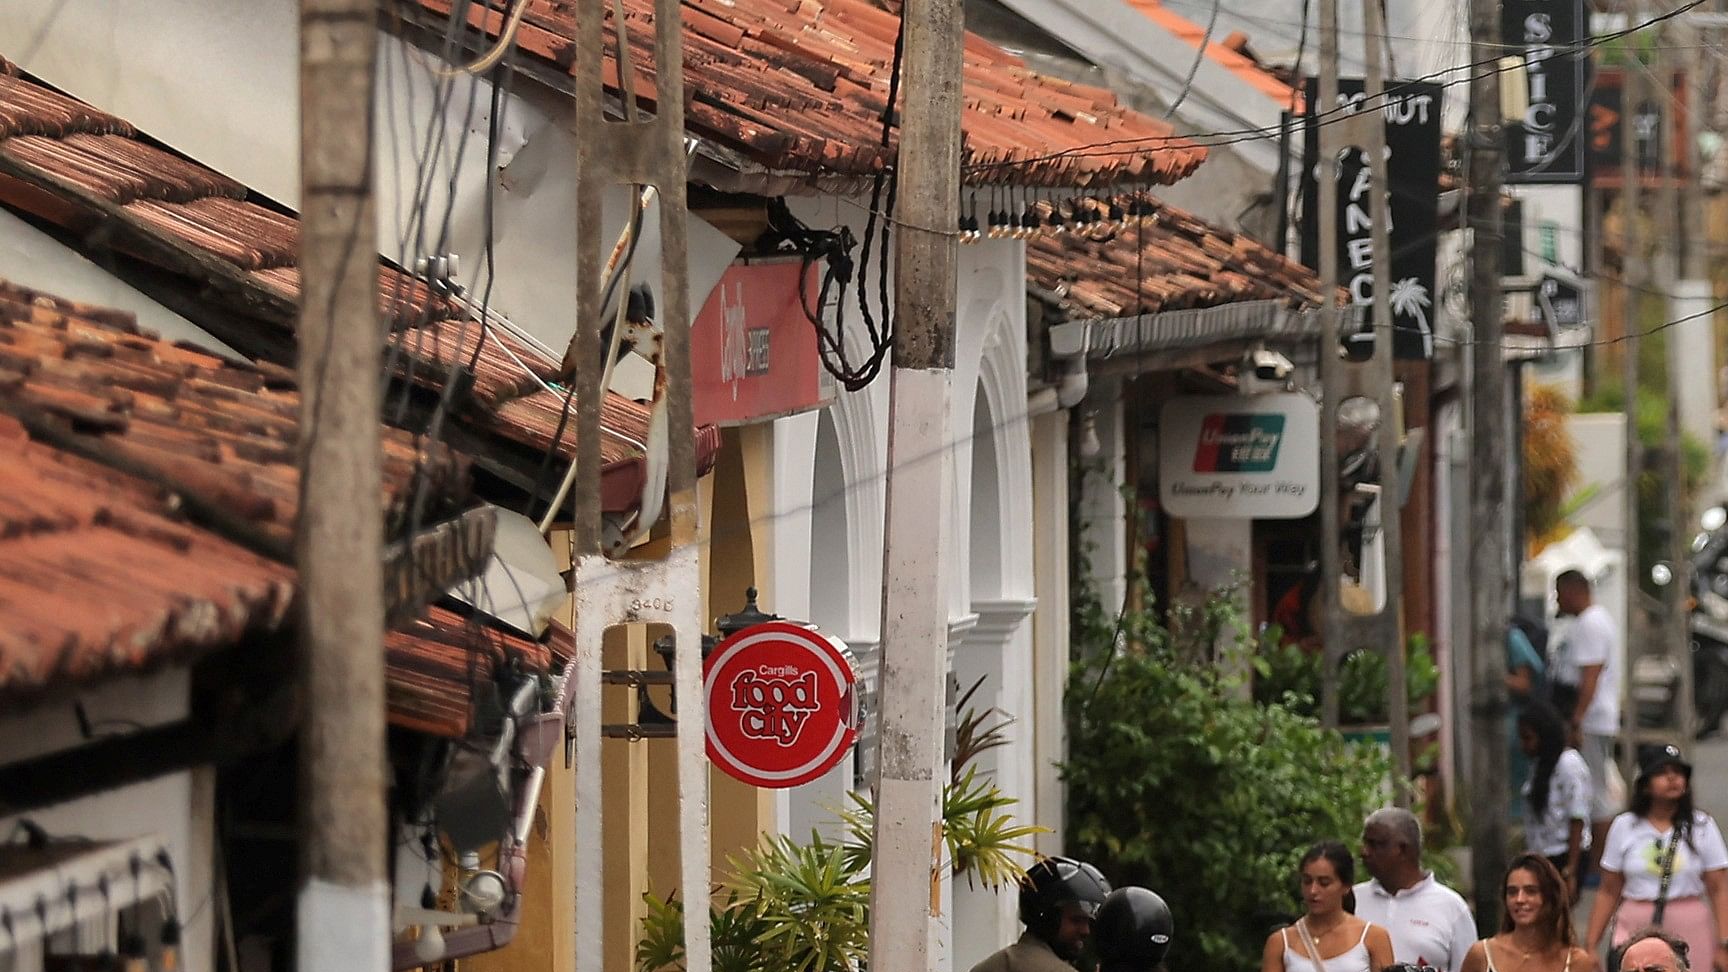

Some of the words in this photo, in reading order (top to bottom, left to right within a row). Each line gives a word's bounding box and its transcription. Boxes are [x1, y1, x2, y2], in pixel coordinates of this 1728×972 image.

[1523, 13, 1557, 164] SPICE
[731, 670, 821, 712] food
[758, 663, 800, 677] Cargills
[740, 702, 811, 748] city
